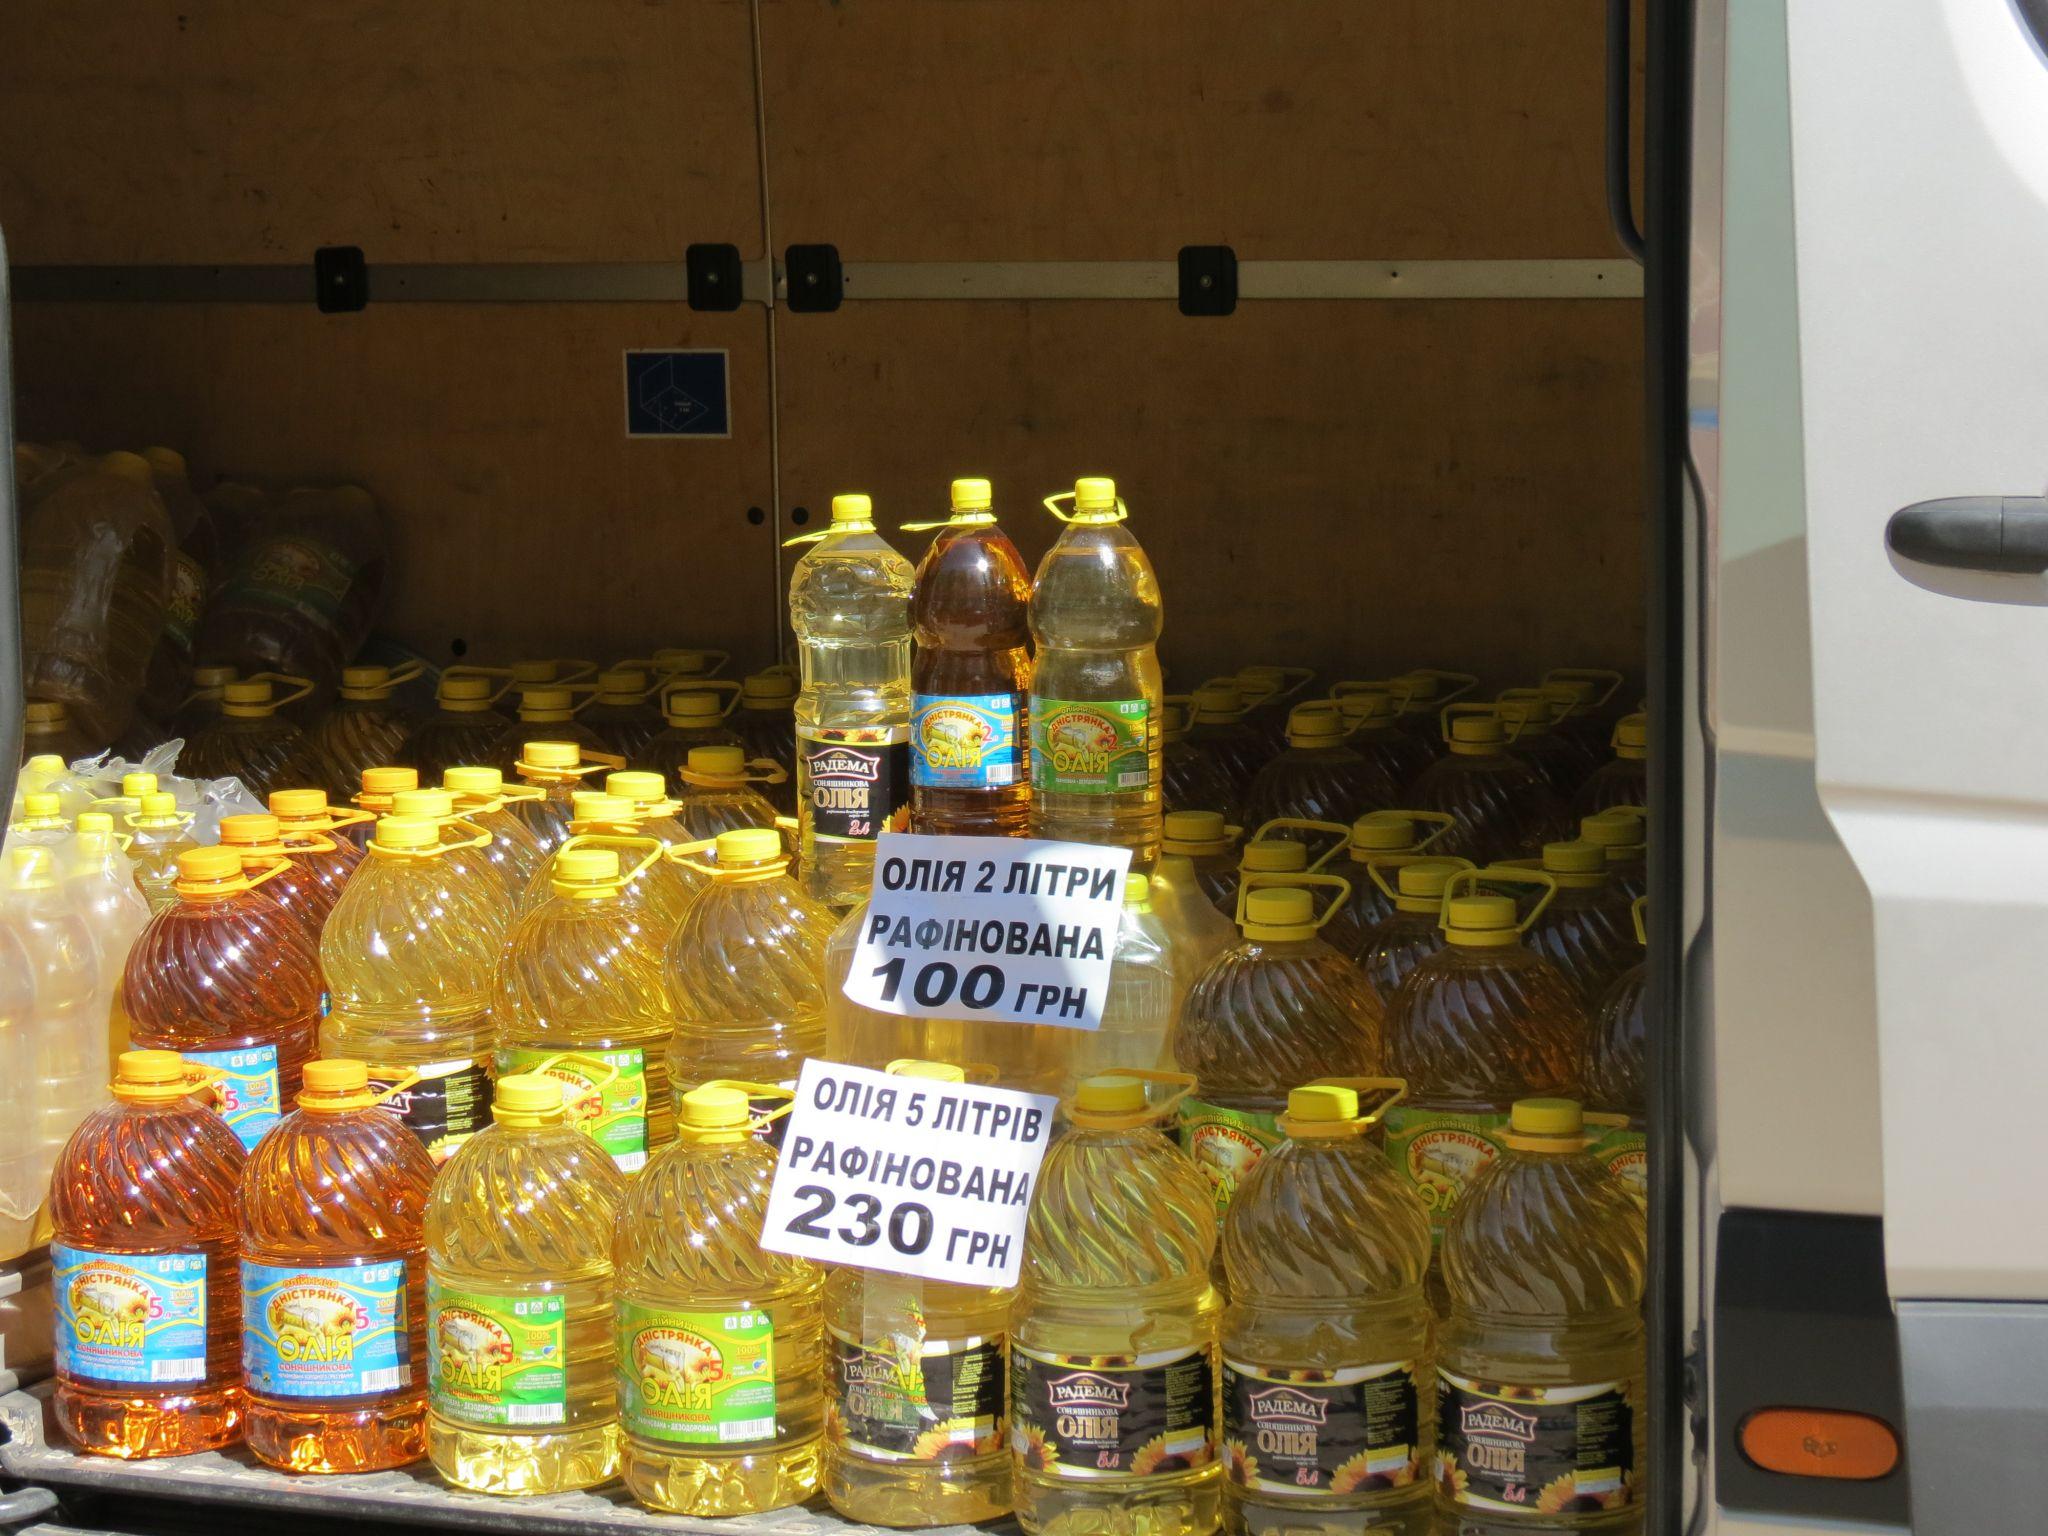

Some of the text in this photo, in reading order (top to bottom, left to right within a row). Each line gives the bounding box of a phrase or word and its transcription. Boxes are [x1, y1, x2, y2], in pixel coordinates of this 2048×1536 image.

[924, 710, 983, 729] ДНІСТРЯНКА
[1052, 714, 1110, 734] ДНІСТРЯНКА
[982, 725, 992, 741] 2
[1107, 734, 1118, 751] 2
[813, 759, 869, 774] РАДЕМА
[926, 746, 982, 768] ОЛІЯ
[1053, 750, 1109, 773] ОЛІЯ
[813, 780, 869, 788] СОНЯШНИКОВА
[813, 787, 870, 809] ОЛІЯ
[882, 857, 1117, 901] ОЛІЯ 2 ЛІТРИ
[867, 914, 1104, 960] РАФІНОВАНА
[871, 957, 1088, 1019] 100 ГРН
[224, 1090, 239, 1111] 5
[590, 1097, 603, 1118] 5
[813, 1077, 1043, 1143] ОЛІЯ 5 ЛІТРІВ
[1193, 1126, 1263, 1158] ДНІСТРЯНКА
[1412, 1133, 1495, 1159] ДНІСТРЯНКА
[789, 1136, 1030, 1206] РАФІНОВАНА
[785, 1184, 1012, 1269] 230 ГРН
[73, 1273, 149, 1299] ДНІСТРЯНКА
[149, 1297, 163, 1319] 5
[271, 1288, 355, 1311] ДНІСТРЯНКА
[355, 1308, 370, 1329] 5
[438, 1311, 502, 1339] ДНІСТРЯНКА
[75, 1316, 145, 1349] ОЛІЯ
[636, 1329, 712, 1357] ДНІСТРЯНКА
[76, 1344, 143, 1358] СОНЯШНИКОВА
[276, 1334, 353, 1362] ОЛІЯ
[499, 1343, 513, 1363] 5
[279, 1362, 352, 1372] СОНЯШНИКОВА
[440, 1355, 502, 1392] ОЛІЯ
[708, 1360, 723, 1381] 5
[640, 1377, 713, 1410] ОЛІЯ
[1056, 1385, 1119, 1400] РАДЕМА
[1057, 1407, 1119, 1416] СОНЯШНИКОВА
[1257, 1400, 1317, 1417] РАДЕМА
[1056, 1415, 1119, 1439] ОЛІЯ
[1257, 1421, 1317, 1432] СОНЯШНИКОВА
[1468, 1414, 1526, 1433] РАДЕМА
[1257, 1430, 1318, 1456] ОЛІЯ
[1467, 1435, 1525, 1449] СОНЯШНИКОВА
[1467, 1443, 1526, 1473] ОЛІЯ
